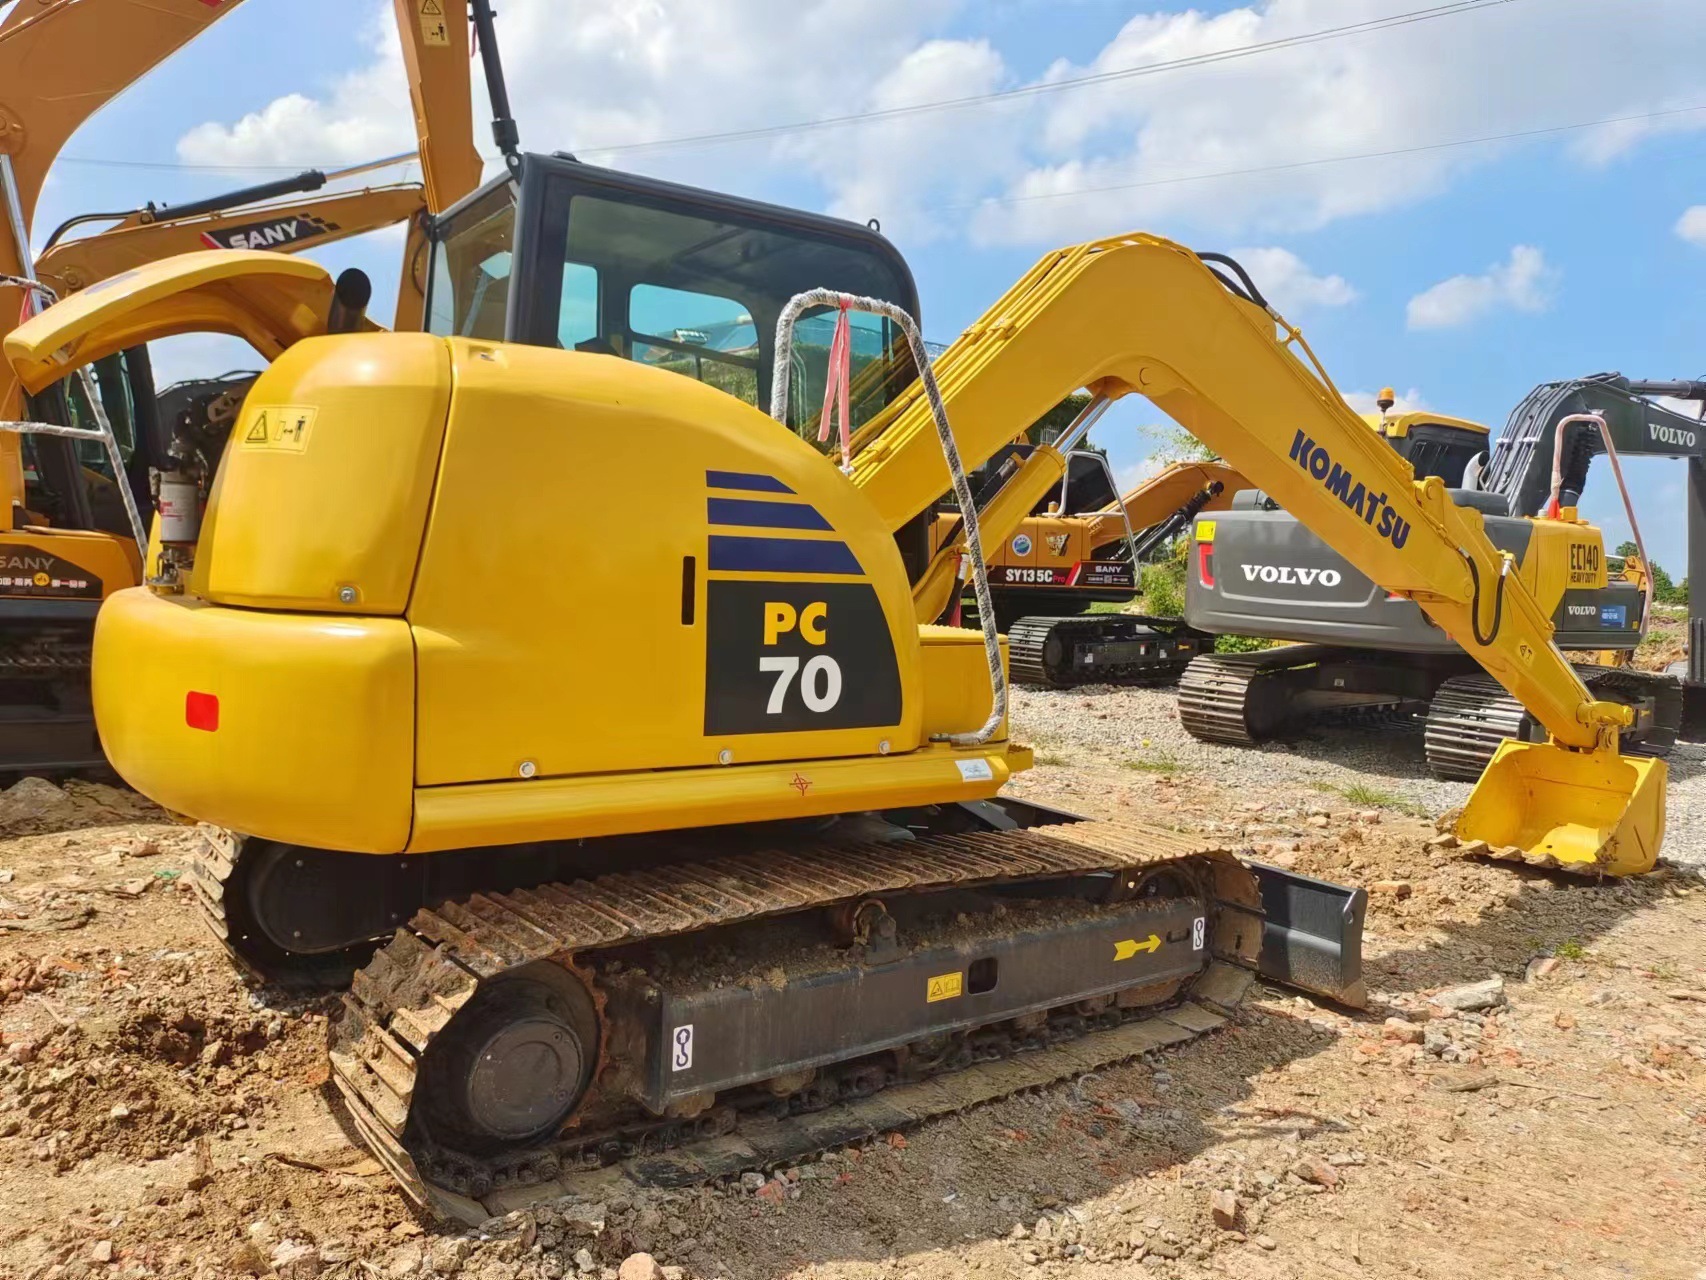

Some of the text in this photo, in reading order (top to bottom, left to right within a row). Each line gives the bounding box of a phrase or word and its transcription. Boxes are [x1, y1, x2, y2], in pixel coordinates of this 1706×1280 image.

[229, 220, 297, 250] SANY
[1648, 423, 1696, 448] VOLVO
[1289, 428, 1411, 549] KOMATSU
[1095, 565, 1122, 573] SANY
[1571, 543, 1598, 571] EC140
[1005, 568, 1053, 582] SY135C
[1240, 564, 1342, 587] VOLVO
[763, 601, 827, 646] PC
[1568, 605, 1596, 616] VOLVO
[759, 655, 842, 714] 70
